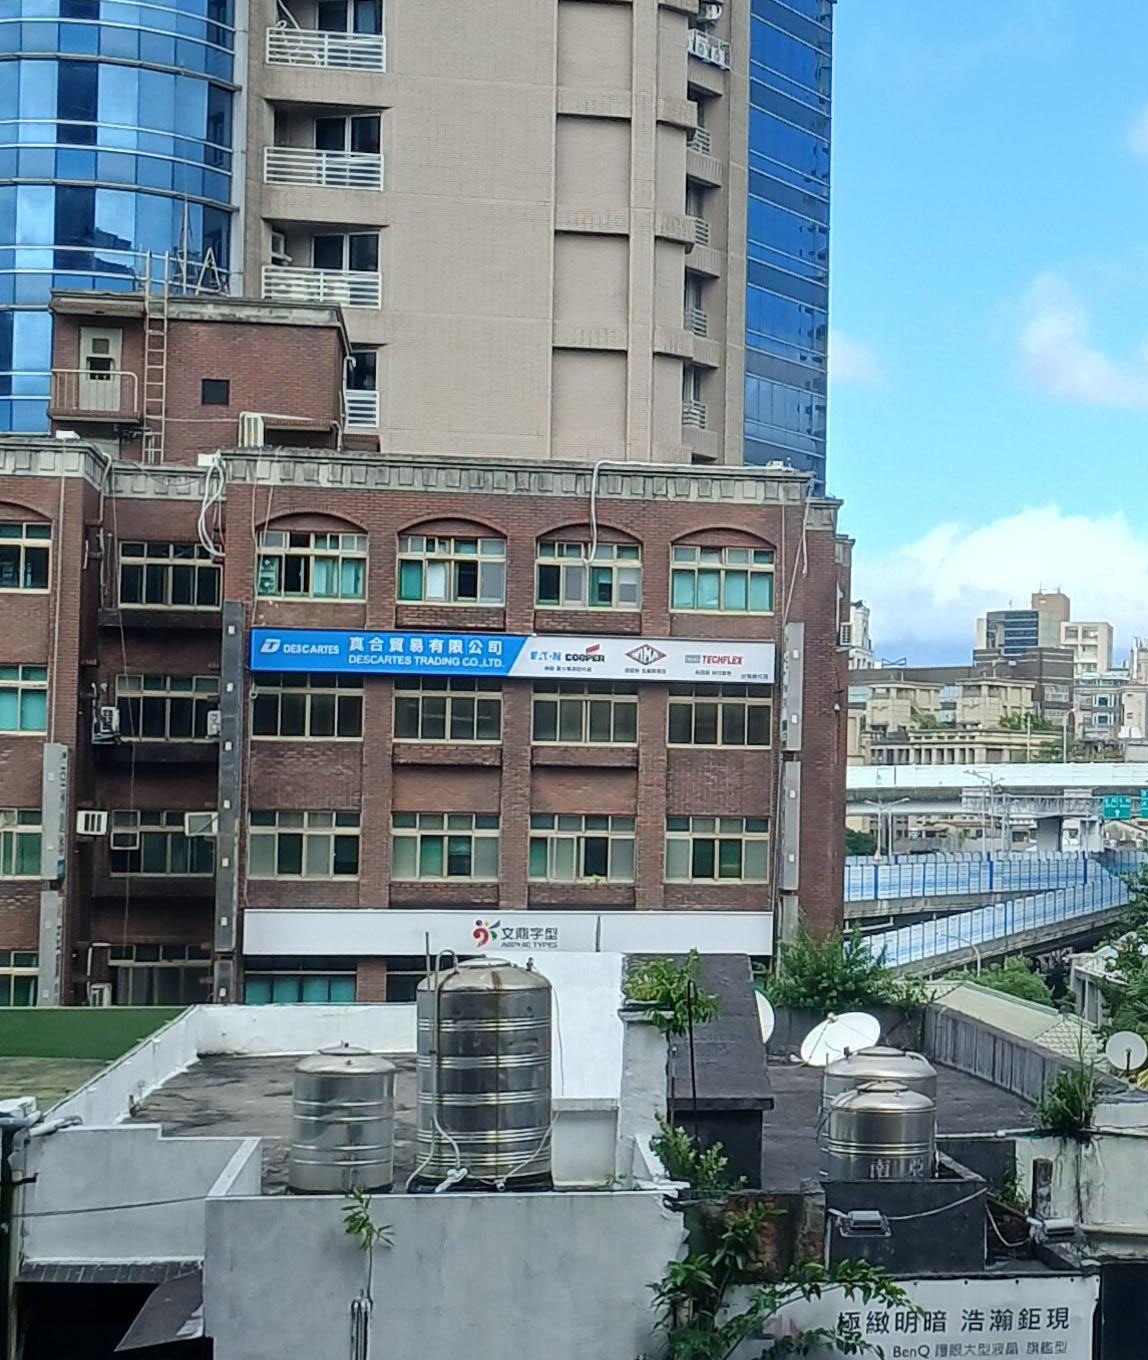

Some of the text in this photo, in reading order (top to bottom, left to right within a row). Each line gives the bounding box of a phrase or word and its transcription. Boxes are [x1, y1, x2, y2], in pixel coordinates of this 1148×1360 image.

[283, 644, 340, 655] DESCARTES
[349, 655, 412, 665] DESCARTES
[414, 656, 460, 667] TRADING
[565, 654, 605, 663] COOPER
[702, 655, 743, 665] TECHFLEX
[501, 927, 558, 940] 文鼎字型
[838, 1306, 1069, 1335] 極緻明暗 浩瀚鉅現
[893, 1344, 930, 1359] BenQ
